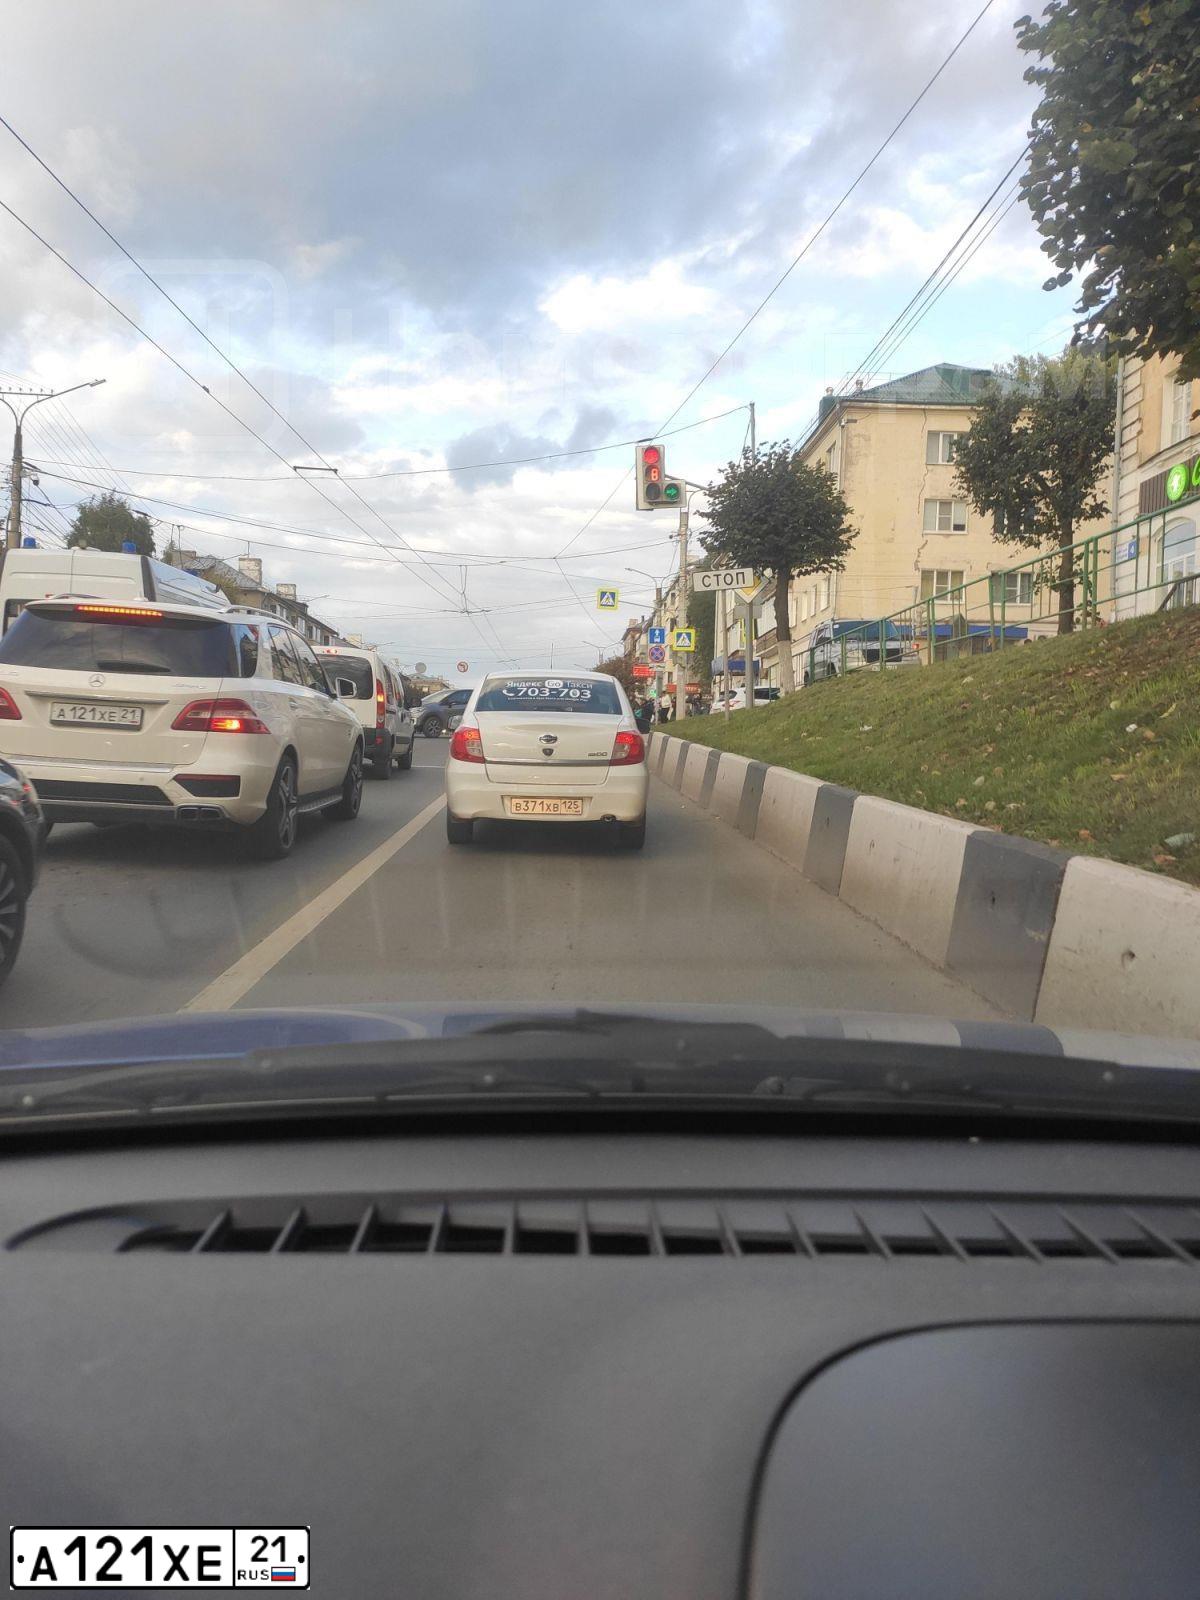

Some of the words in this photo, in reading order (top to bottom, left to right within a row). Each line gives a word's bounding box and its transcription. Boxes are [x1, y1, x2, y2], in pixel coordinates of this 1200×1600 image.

[651, 468, 659, 481] 8
[702, 572, 745, 588] СТОП
[506, 680, 542, 688] Яндекс
[567, 681, 593, 689] Такси
[516, 687, 591, 699] 703-703
[121, 709, 136, 719] 21
[515, 800, 559, 812] В371ХВ
[562, 801, 579, 810] 125
